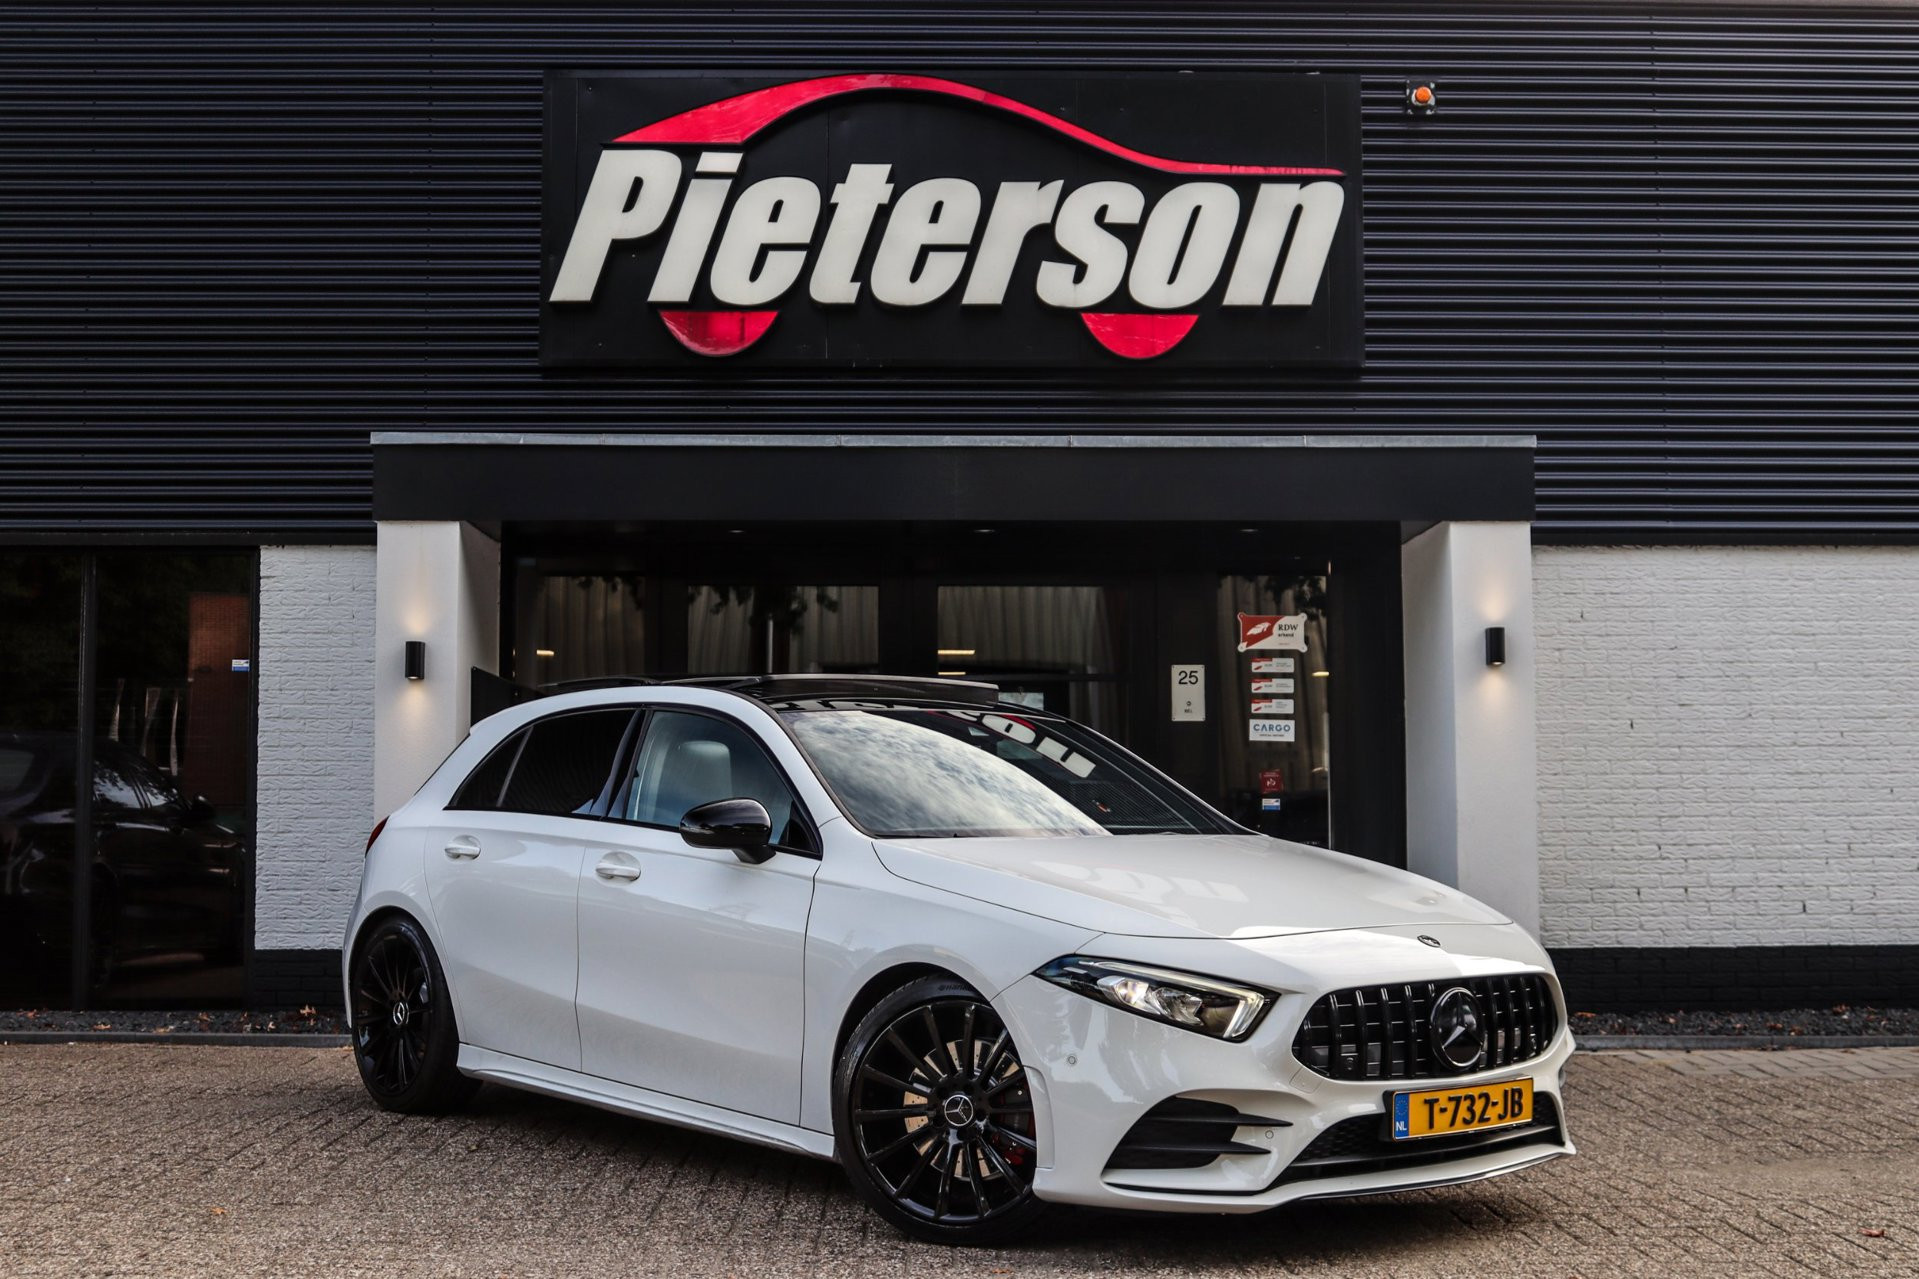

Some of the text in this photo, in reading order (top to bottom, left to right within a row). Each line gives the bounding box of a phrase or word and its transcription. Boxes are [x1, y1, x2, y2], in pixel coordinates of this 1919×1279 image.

[548, 148, 1345, 309] Pieterson
[1278, 623, 1299, 631] RDW
[1178, 670, 1199, 685] 25
[1253, 723, 1291, 732] CARGO
[1423, 1087, 1524, 1130] T-732-JB
[1395, 1121, 1408, 1131] NL
